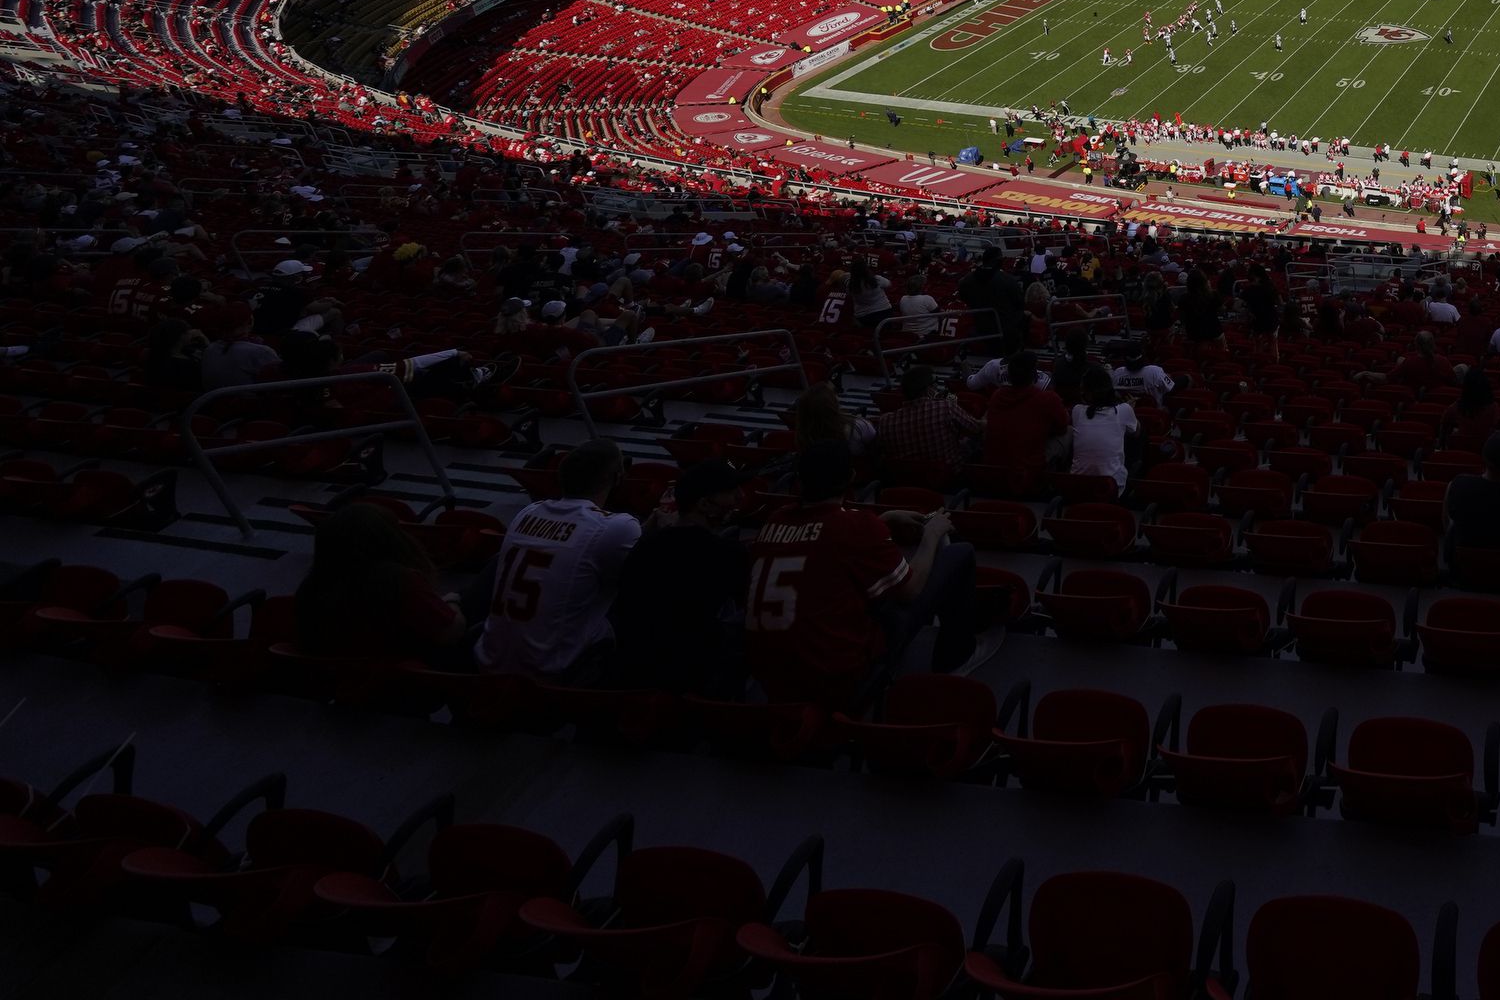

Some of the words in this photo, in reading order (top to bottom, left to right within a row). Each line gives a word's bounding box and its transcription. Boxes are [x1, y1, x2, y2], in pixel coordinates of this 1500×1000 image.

[818, 15, 851, 34] Ford
[1036, 51, 1060, 61] 10
[1177, 63, 1206, 75] 30
[1257, 70, 1285, 82] 40
[1335, 77, 1367, 89] 50
[1419, 85, 1452, 98] 40
[991, 190, 1109, 213] HONORS
[1141, 203, 1205, 217] FRONT
[1206, 211, 1246, 222] THE
[1301, 223, 1368, 237] THOSE
[106, 289, 124, 314] 15
[818, 298, 845, 324] 15
[939, 317, 959, 337] 15
[1118, 376, 1145, 386] JACKSON
[514, 514, 577, 542] MAHOMES
[755, 521, 825, 543] MAHOMES
[494, 545, 554, 621] 15
[745, 555, 808, 631] 15
